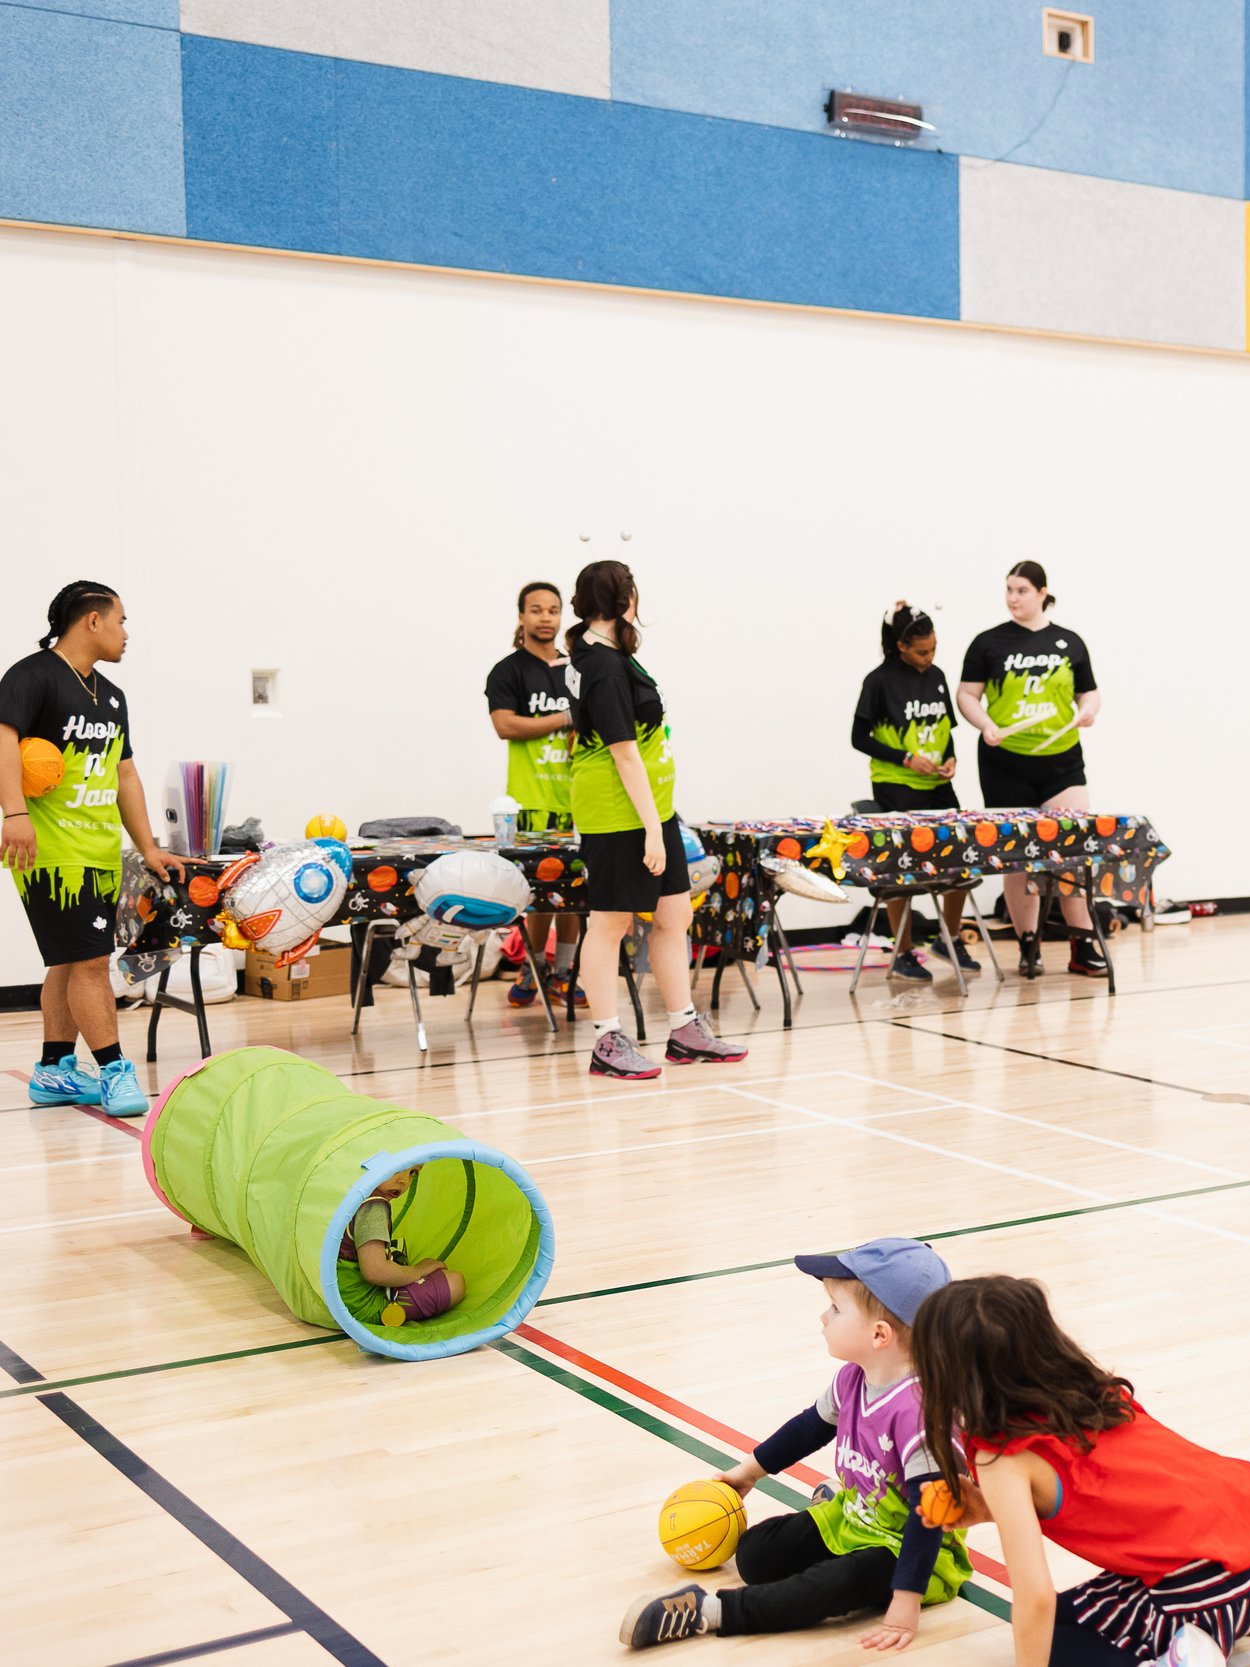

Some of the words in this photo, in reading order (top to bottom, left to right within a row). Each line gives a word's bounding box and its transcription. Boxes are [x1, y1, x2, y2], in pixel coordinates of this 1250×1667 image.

[1004, 653, 1065, 671] Hoop
[528, 691, 571, 714] Hoo
[904, 699, 947, 720] Hoop
[63, 714, 118, 745] Hoop
